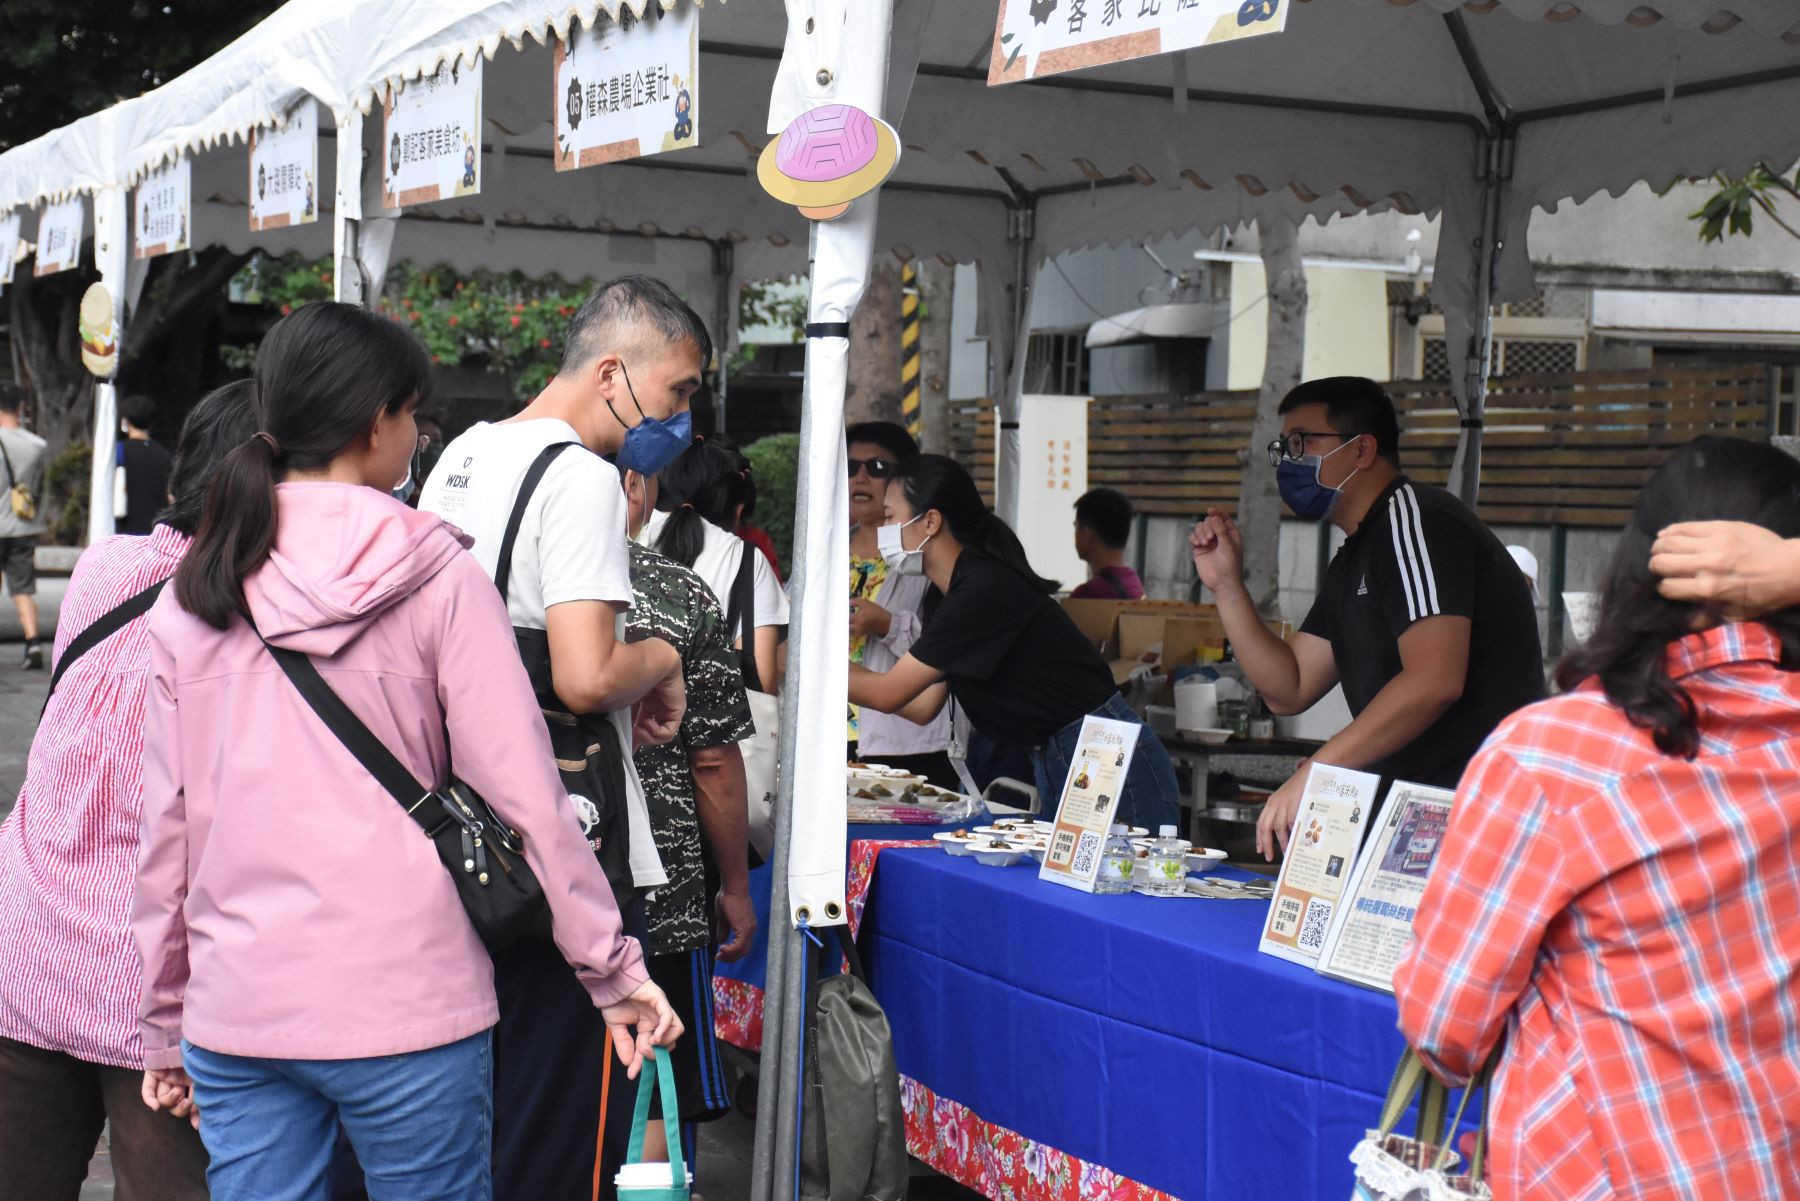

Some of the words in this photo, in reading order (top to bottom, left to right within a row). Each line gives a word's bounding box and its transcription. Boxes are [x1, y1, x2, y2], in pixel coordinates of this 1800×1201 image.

[570, 93, 580, 116] 05
[585, 63, 670, 119] 權森農場企業社
[446, 474, 471, 489] WDSK
